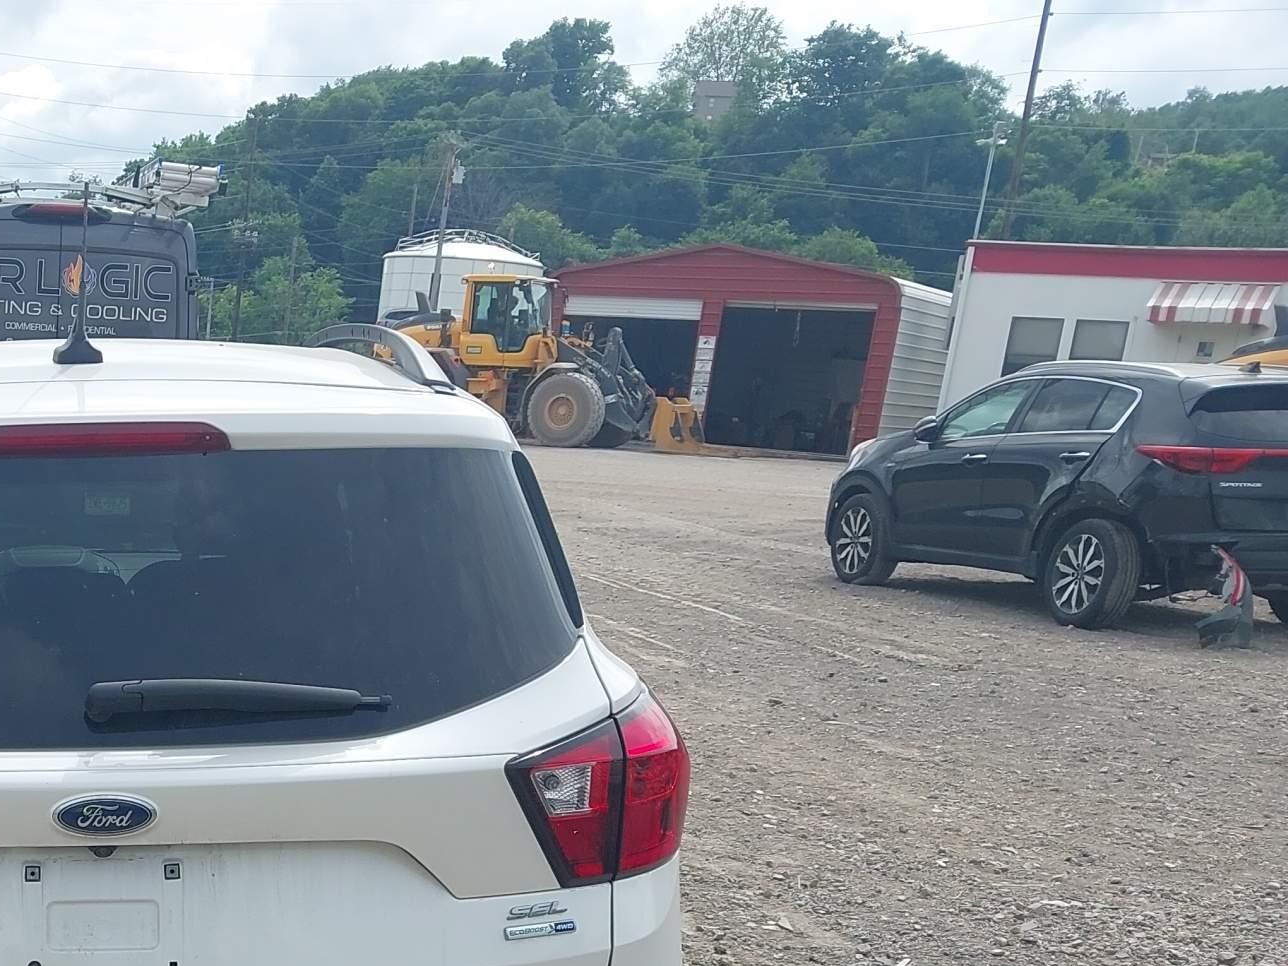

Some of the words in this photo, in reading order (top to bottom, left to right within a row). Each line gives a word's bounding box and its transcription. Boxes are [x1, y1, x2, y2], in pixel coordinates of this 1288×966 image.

[50, 303, 63, 316] &
[5, 321, 57, 332] COMMERCIAL
[77, 804, 133, 828] Ford
[506, 900, 568, 921] SEL
[556, 922, 573, 931] 4WD
